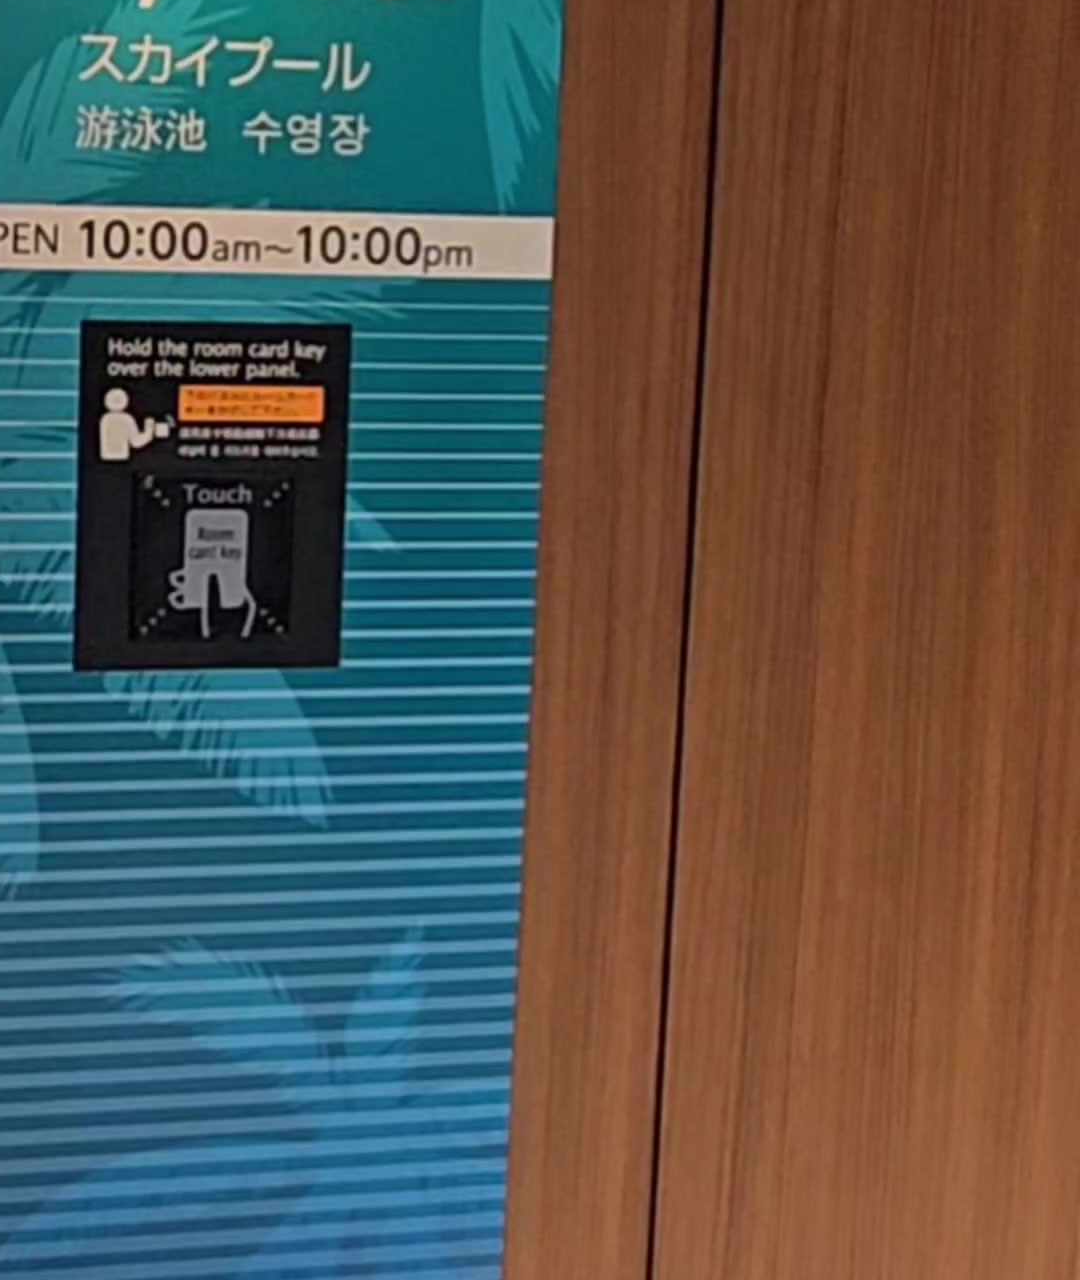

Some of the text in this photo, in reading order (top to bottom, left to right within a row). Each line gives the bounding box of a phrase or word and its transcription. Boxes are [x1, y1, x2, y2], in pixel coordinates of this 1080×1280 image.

[77, 33, 372, 91] スカイプール
[74, 104, 208, 151] 游泳池
[241, 111, 370, 156] 수영장
[107, 338, 327, 361] Hold the room card key
[107, 360, 301, 381] over the lower panel.
[183, 482, 253, 504] Touch
